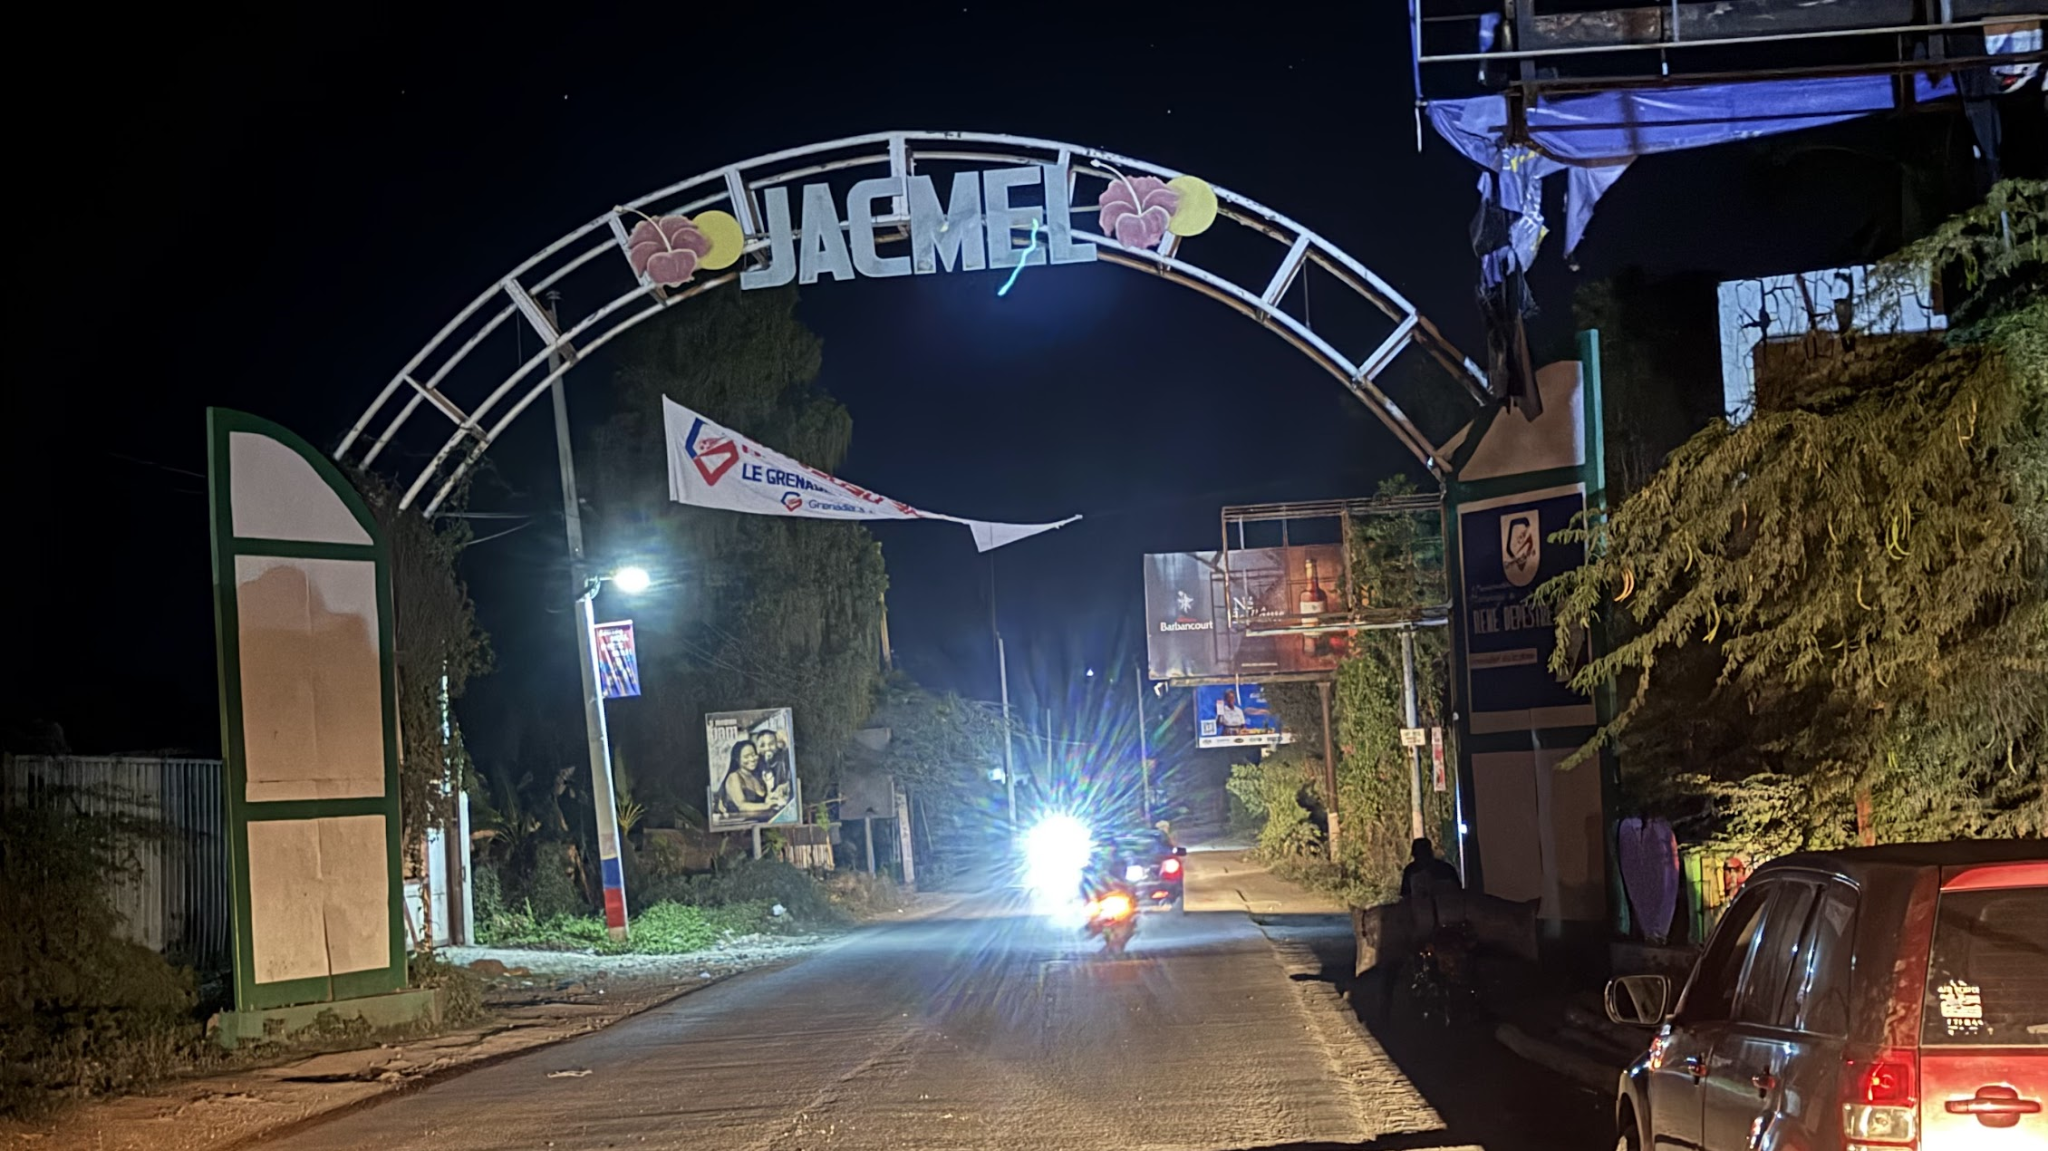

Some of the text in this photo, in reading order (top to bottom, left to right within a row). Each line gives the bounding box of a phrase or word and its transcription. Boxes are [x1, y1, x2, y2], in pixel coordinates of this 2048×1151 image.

[740, 164, 1097, 291] JACMEL
[742, 463, 762, 482] LE
[1160, 620, 1213, 632] Barbancourt
